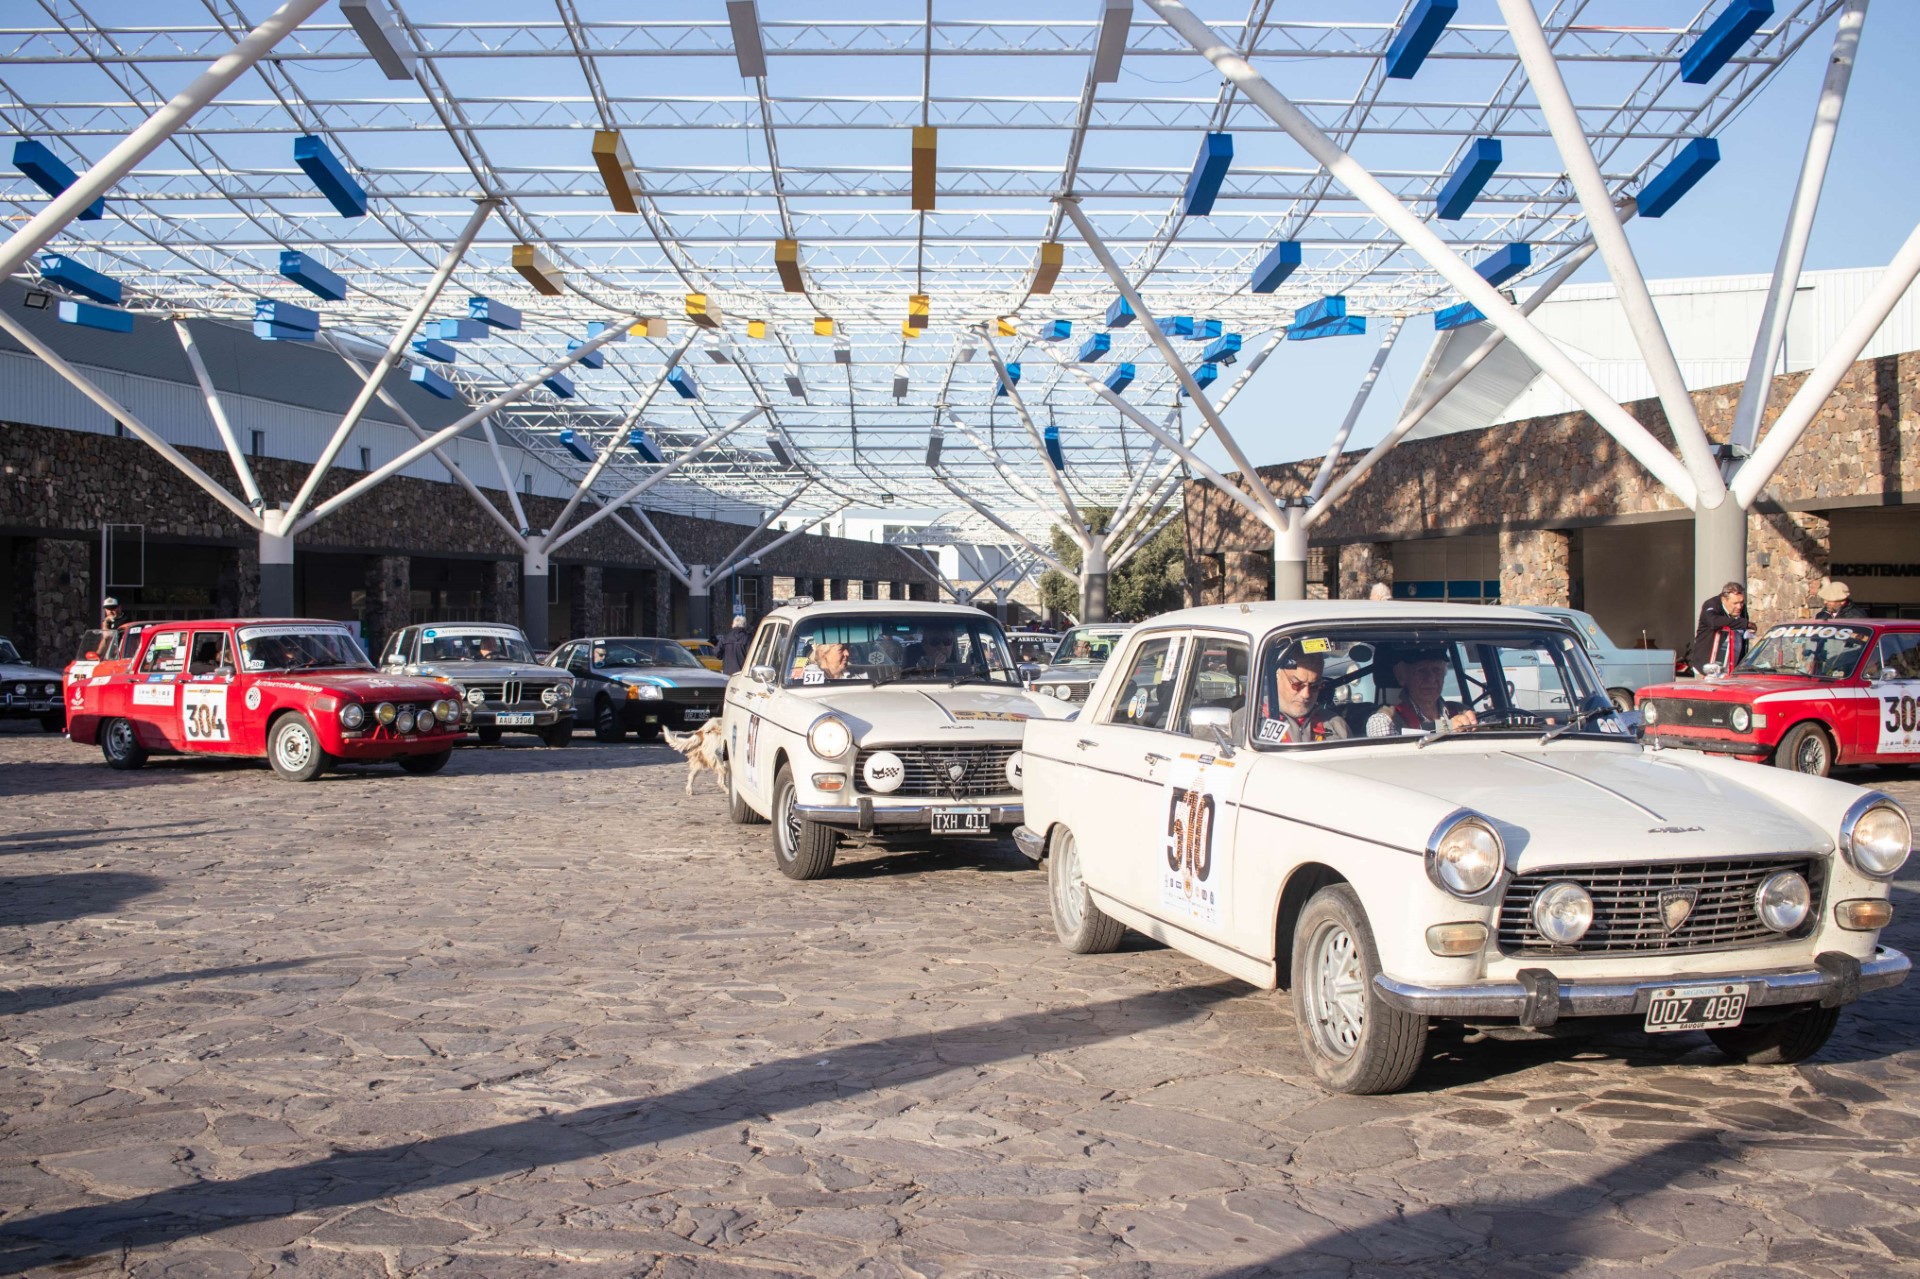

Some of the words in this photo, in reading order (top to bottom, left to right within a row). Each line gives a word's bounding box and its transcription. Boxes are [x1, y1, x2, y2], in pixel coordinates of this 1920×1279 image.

[1771, 626, 1853, 640] OLIVOS
[805, 674, 822, 683] 517
[186, 704, 225, 738] 304
[1884, 696, 1920, 733] 30
[1262, 721, 1285, 740] 509
[935, 815, 958, 829] TXH
[966, 815, 988, 829] 411
[1651, 999, 1693, 1024] UOZ
[1703, 996, 1742, 1020] 488
